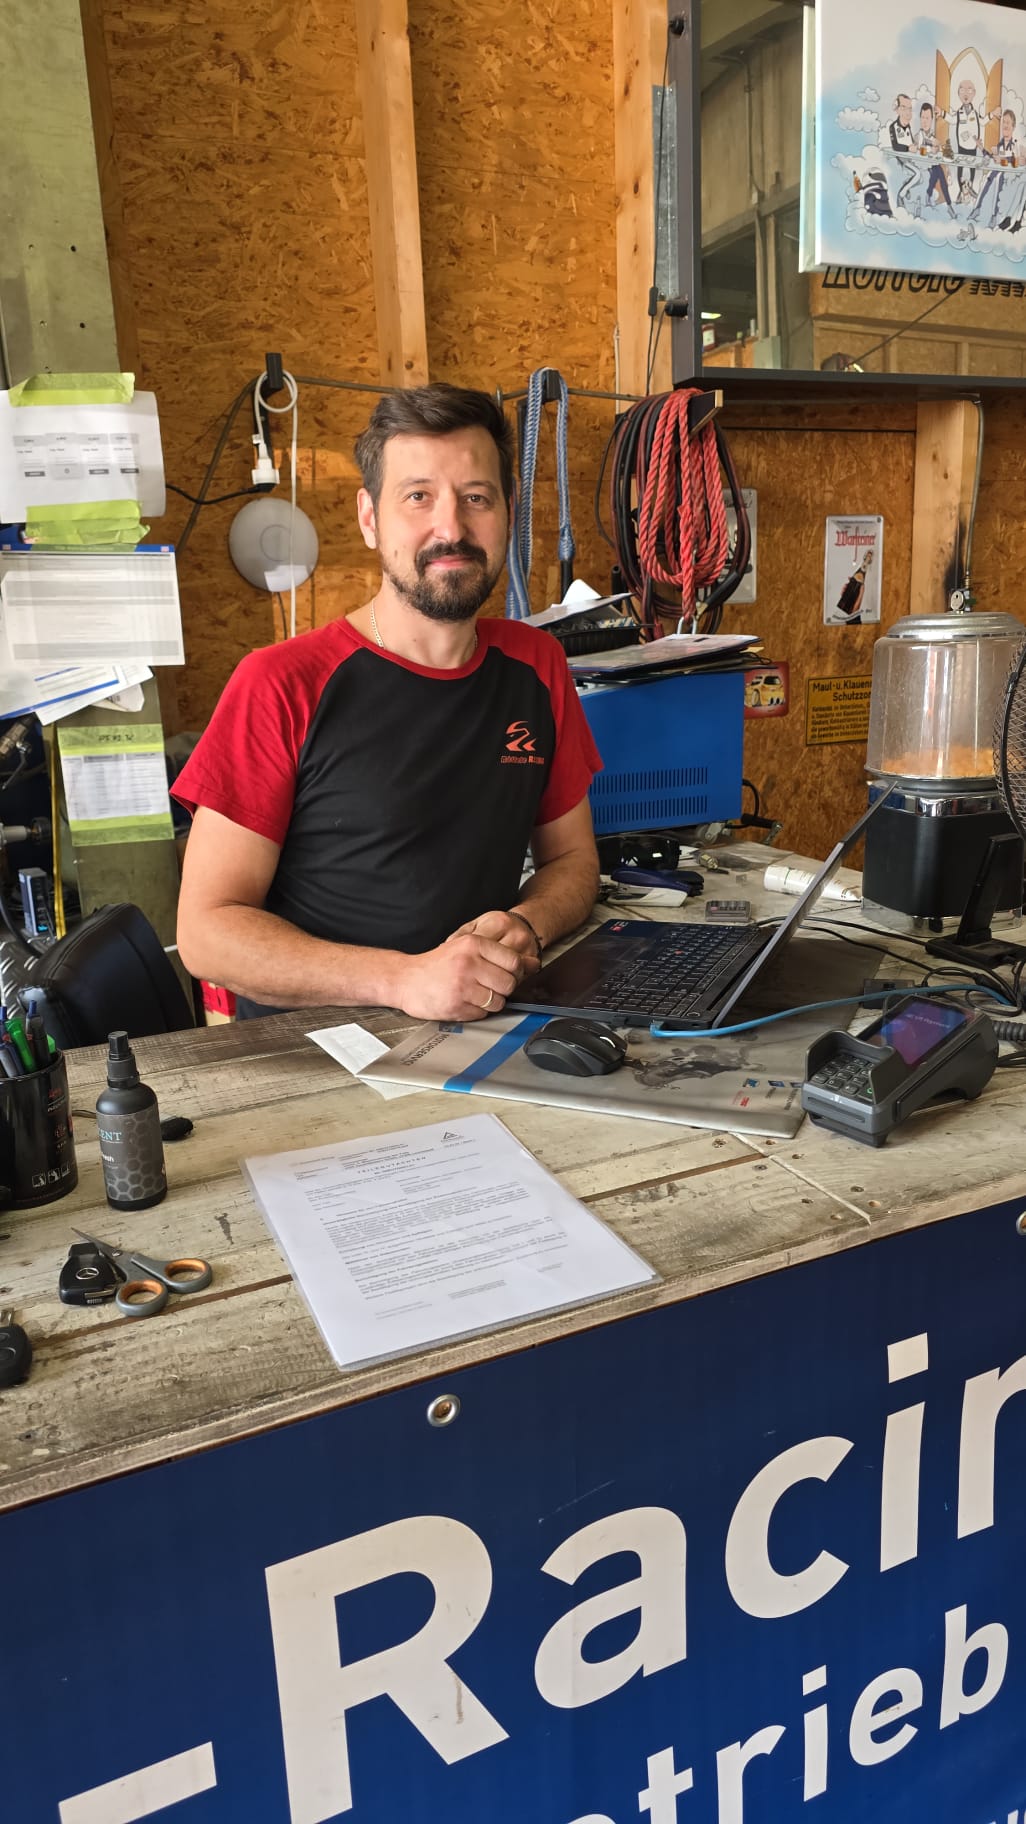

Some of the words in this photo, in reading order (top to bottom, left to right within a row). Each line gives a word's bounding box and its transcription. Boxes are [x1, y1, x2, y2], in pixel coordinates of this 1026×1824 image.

[843, 679, 872, 689] Klauen
[832, 691, 871, 702] Schutzzon
[566, 1604, 1009, 1824] trieb
